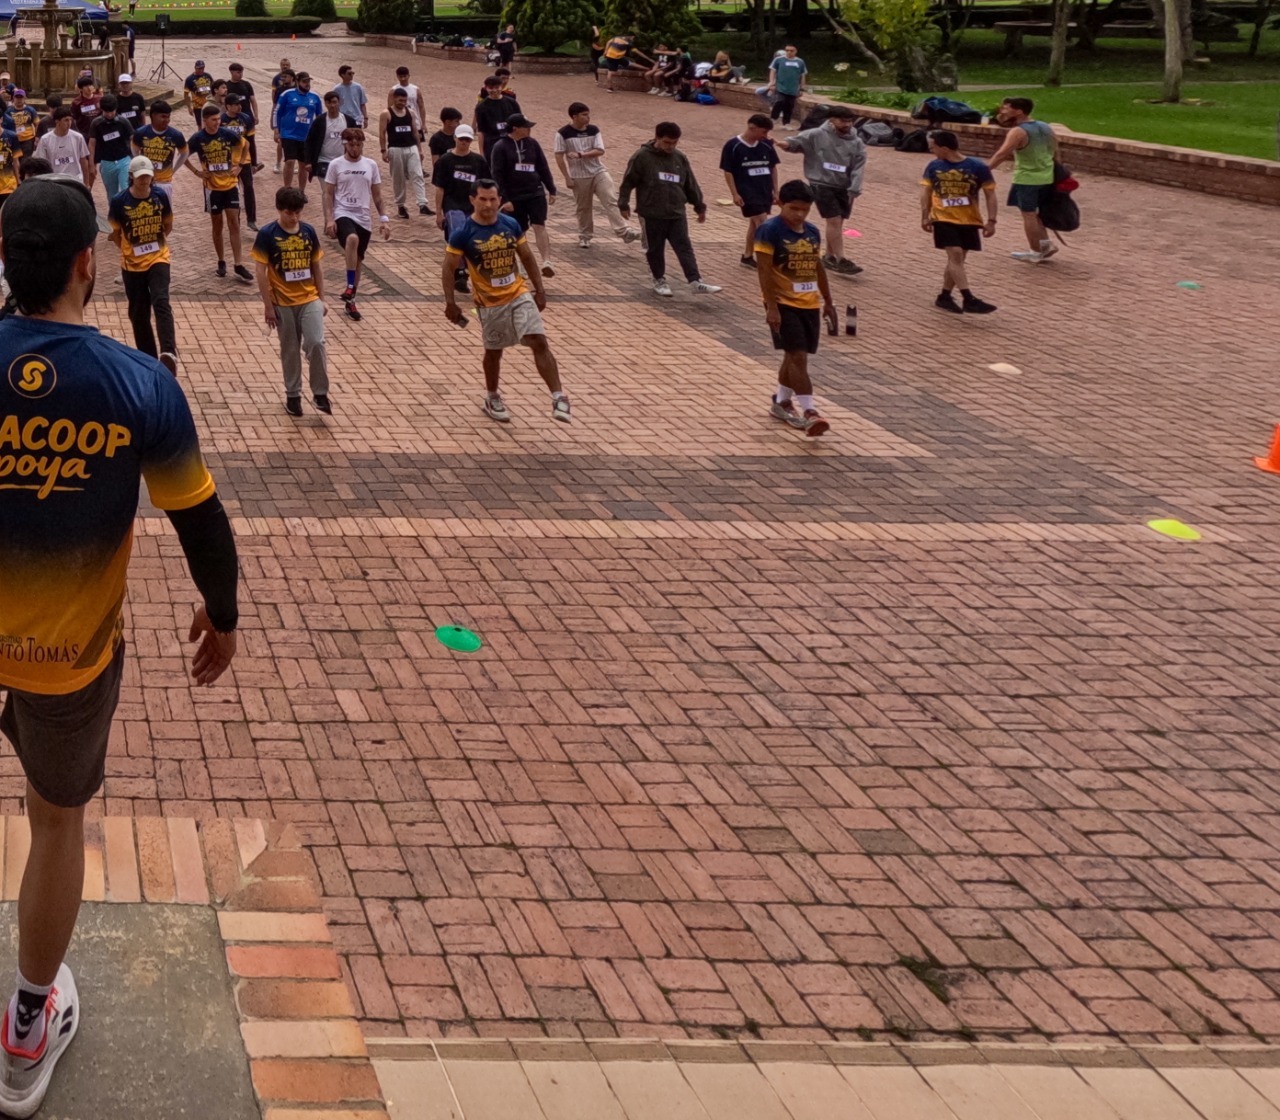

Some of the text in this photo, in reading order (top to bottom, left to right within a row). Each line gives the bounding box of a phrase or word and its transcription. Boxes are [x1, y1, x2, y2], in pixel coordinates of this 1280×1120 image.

[131, 216, 162, 227] SANTOTO
[132, 224, 161, 237] CORRE
[140, 244, 153, 253] 149
[788, 260, 817, 270] CORR
[292, 271, 306, 279] 150
[27, 637, 79, 663] TOMÁS
